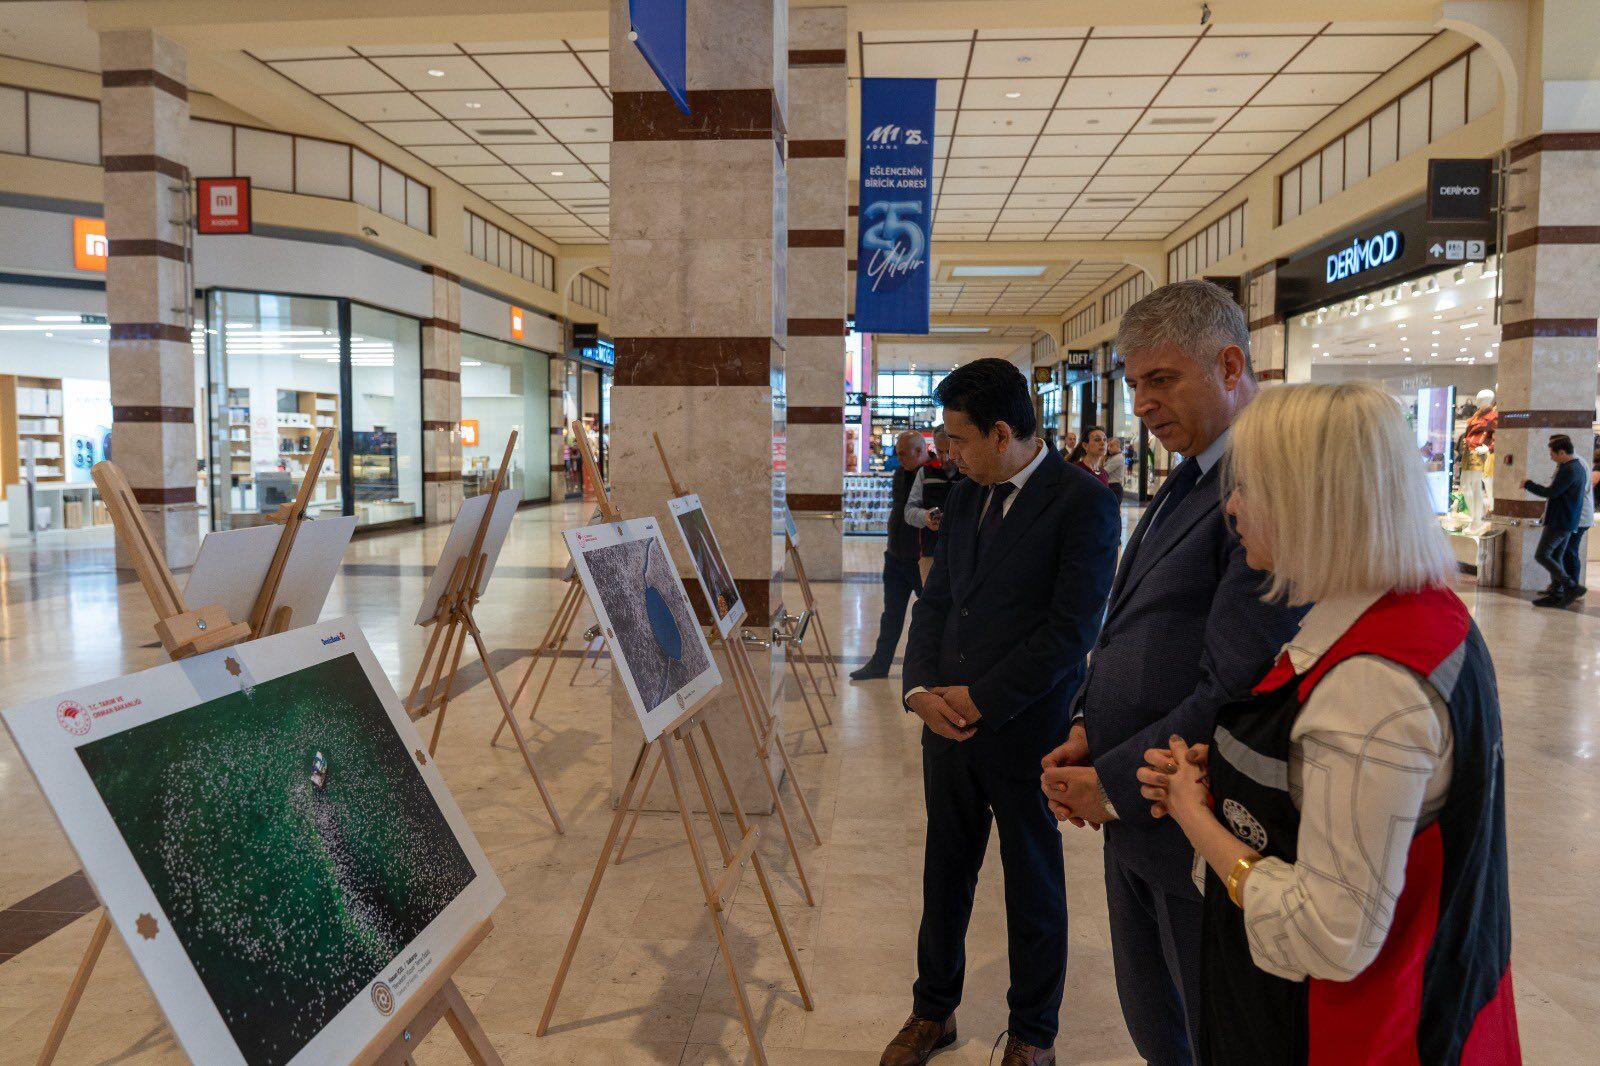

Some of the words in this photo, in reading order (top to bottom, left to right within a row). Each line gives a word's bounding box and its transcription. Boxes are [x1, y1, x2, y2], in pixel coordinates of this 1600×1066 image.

[869, 165, 923, 176] EĞLENCENİN
[864, 178, 895, 188] BİRİCİK
[896, 179, 927, 188] ADRESİ
[1439, 185, 1480, 196] DERİMOD
[1326, 229, 1397, 284] DERİMOD
[1068, 354, 1088, 364] LOFT
